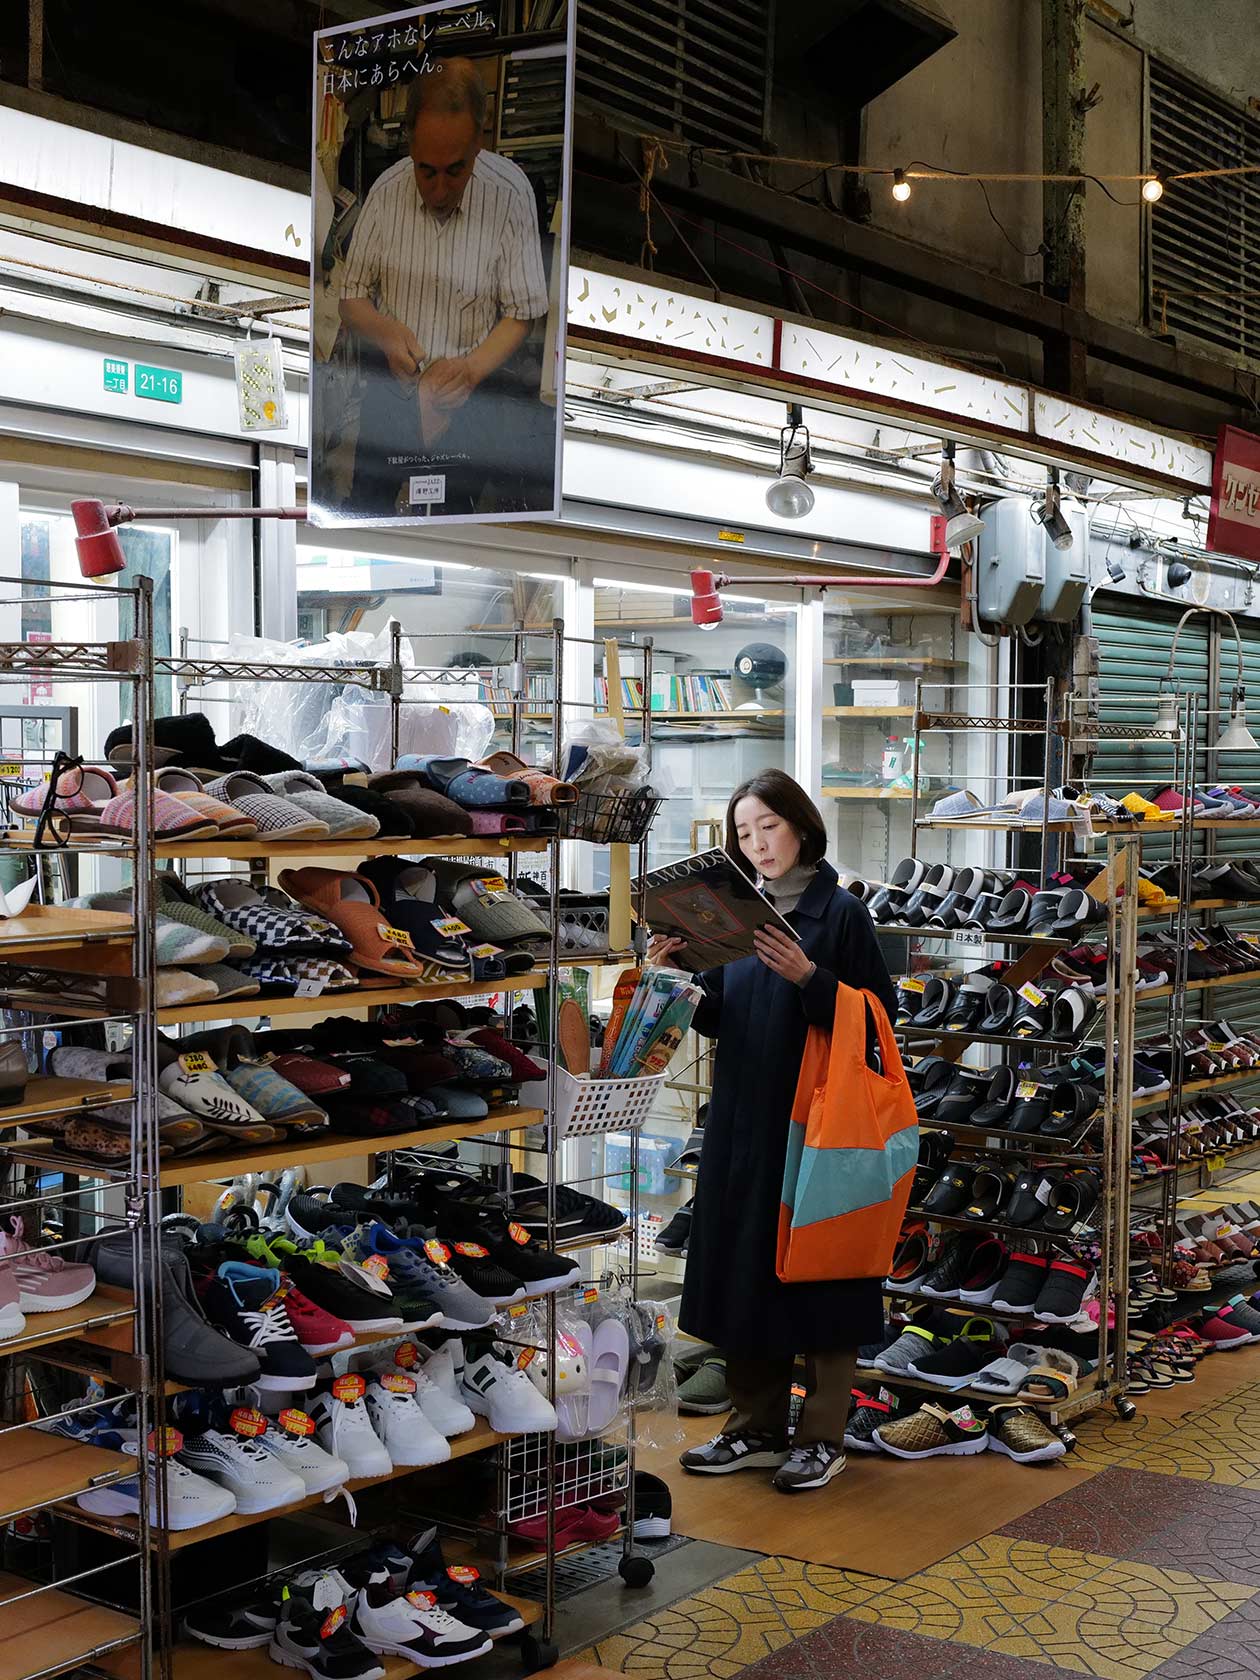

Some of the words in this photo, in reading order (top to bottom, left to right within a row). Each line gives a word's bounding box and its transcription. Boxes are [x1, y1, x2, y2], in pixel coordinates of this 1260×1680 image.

[323, 11, 496, 63] こんなアホなレーベル、
[323, 52, 443, 95] 日本にあらへん。
[140, 373, 178, 395] 21-16
[655, 850, 727, 883] WOODS
